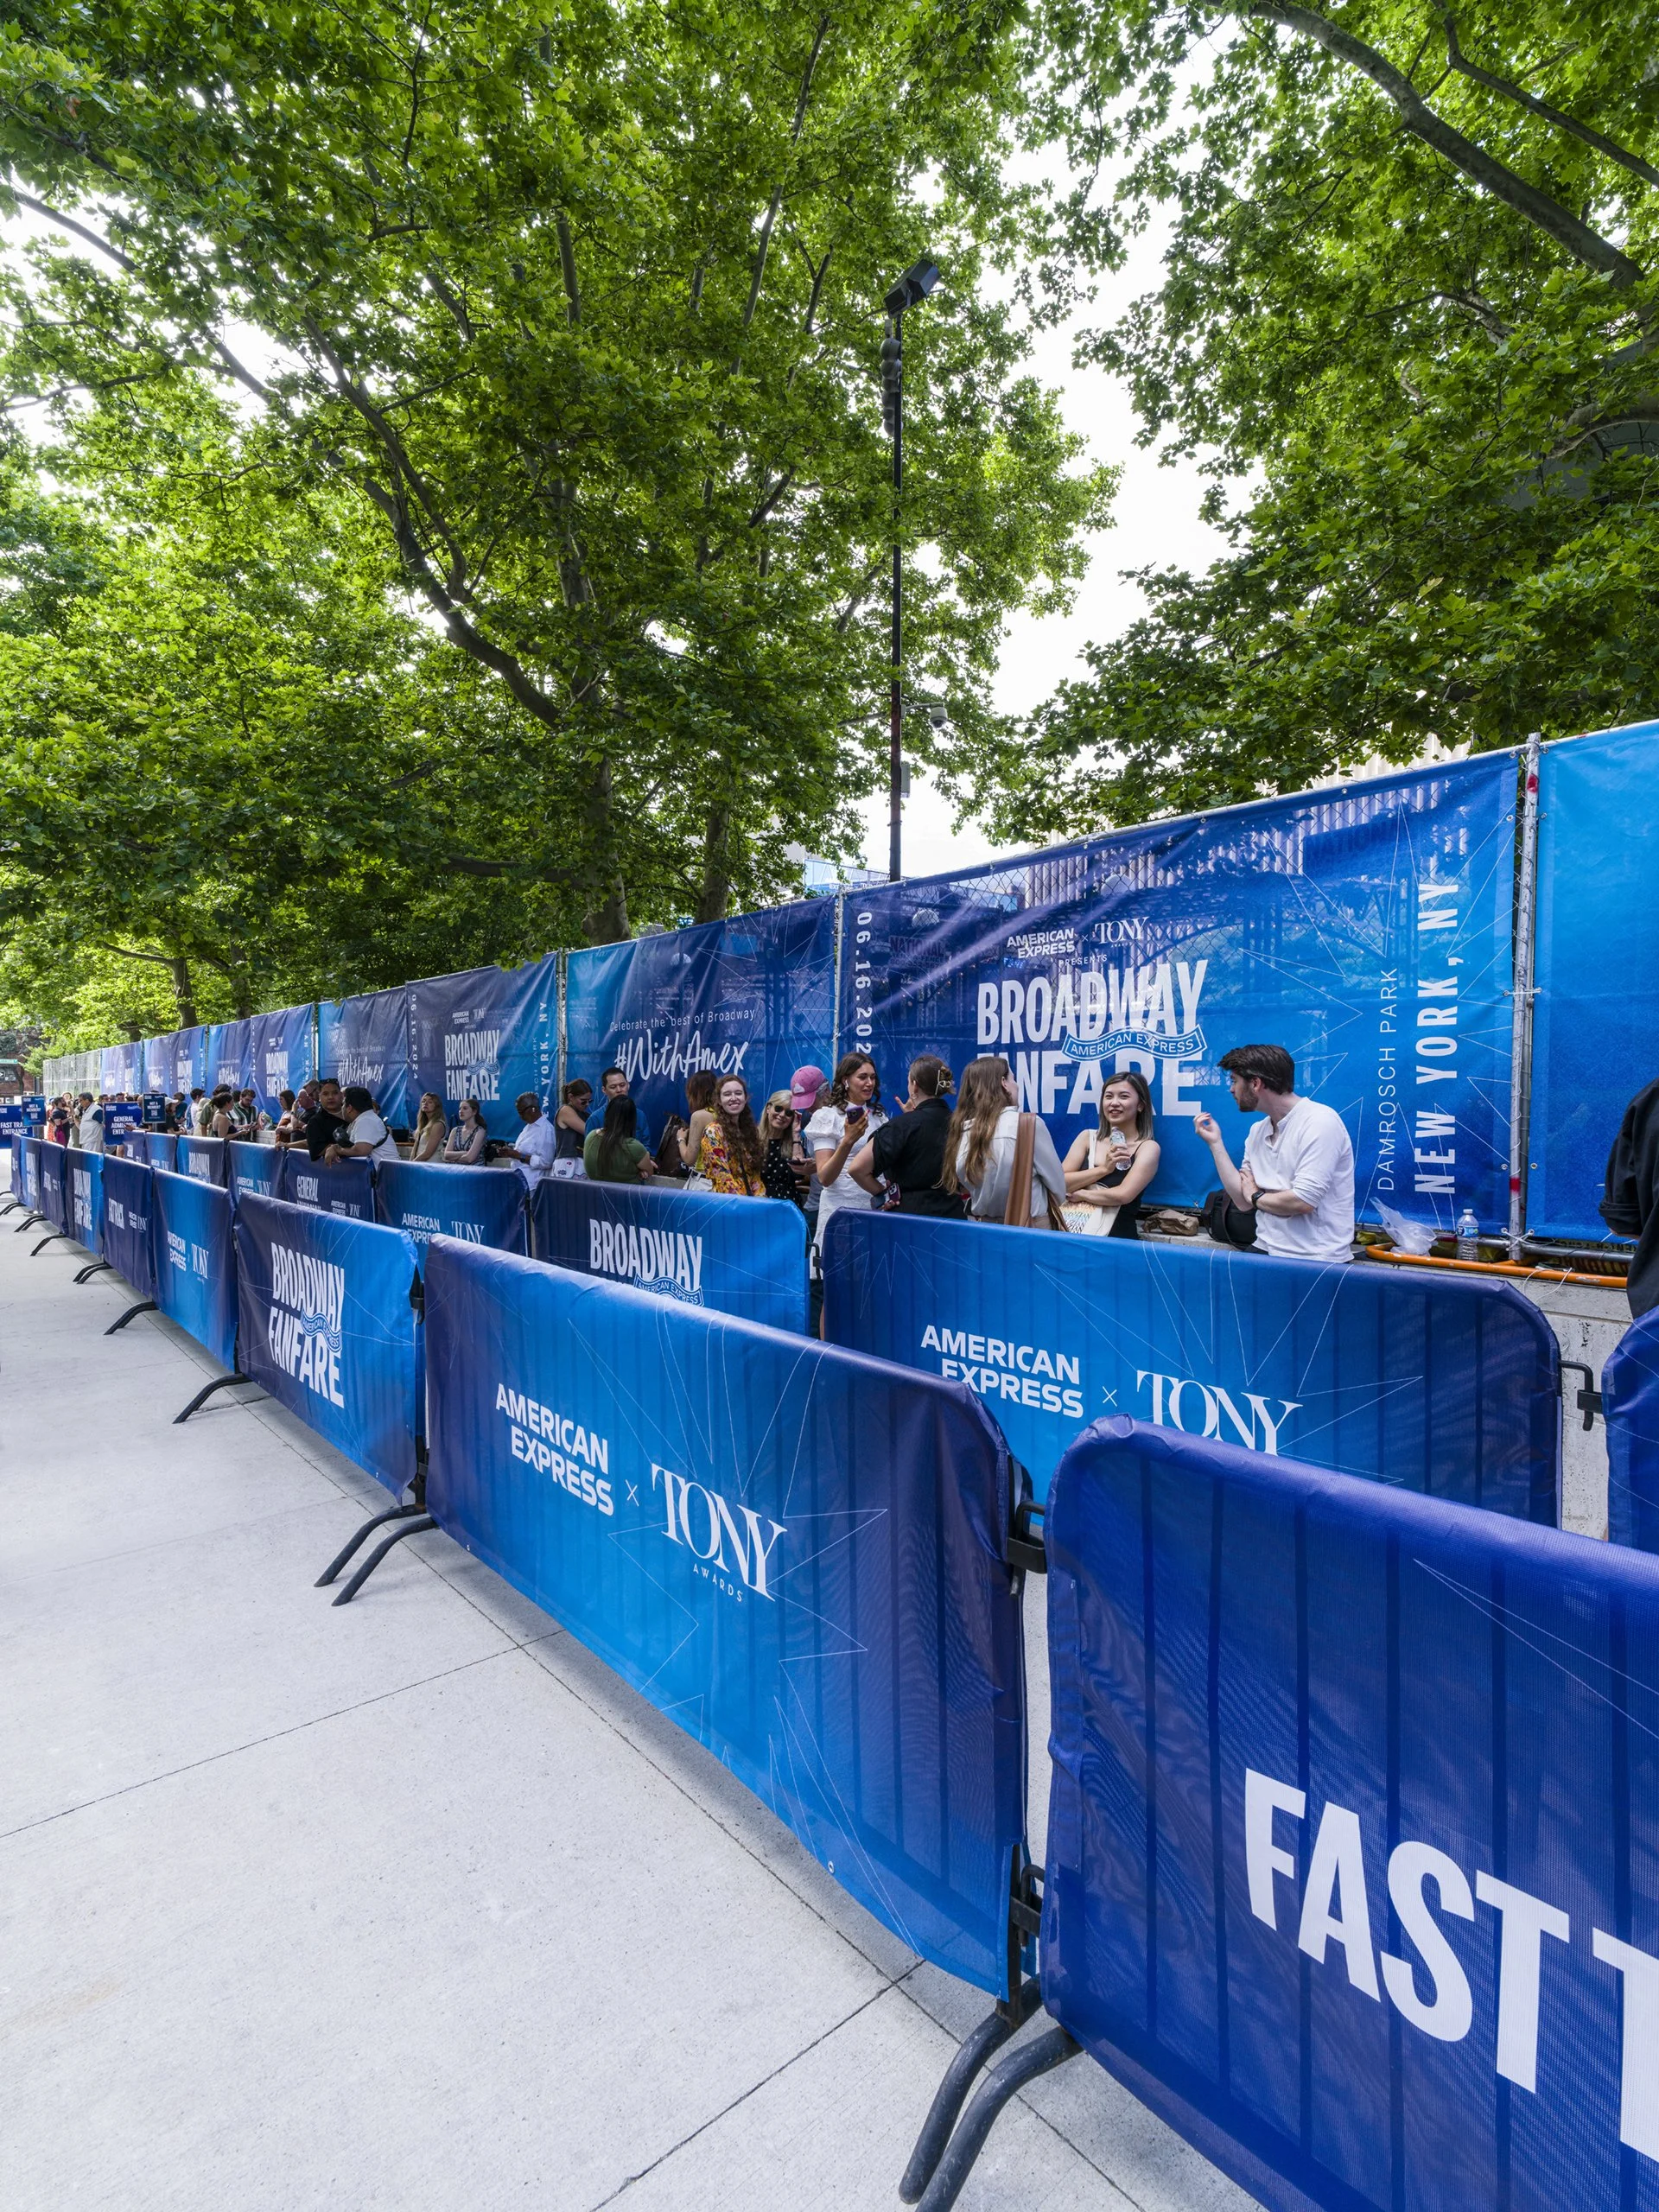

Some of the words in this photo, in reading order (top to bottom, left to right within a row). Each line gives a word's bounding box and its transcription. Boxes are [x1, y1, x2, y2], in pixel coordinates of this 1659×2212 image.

[1007, 928, 1075, 948] AMERICAN
[1094, 917, 1149, 944] TONY
[1417, 883, 1459, 931] NY
[1017, 940, 1076, 959] EXPRESS
[1058, 954, 1108, 967] PRESENTS
[855, 912, 873, 1053] 06.16.202
[977, 959, 1209, 1045] BROADWAY
[1380, 968, 1398, 1033] PARK
[539, 1002, 548, 1022] NY
[610, 1020, 648, 1032] Celebrate
[651, 1017, 665, 1028] the
[671, 1015, 690, 1027] best
[694, 1012, 704, 1024] of
[708, 1009, 755, 1023] Broadway
[1415, 957, 1465, 1084] YORK,
[444, 1030, 499, 1066] BROADWAY
[540, 1033, 550, 1085] YORK,
[614, 1029, 749, 1082] #WithAmex
[1071, 1033, 1131, 1056] AMERICAN
[1136, 1033, 1194, 1052] EXPRESS
[446, 1070, 500, 1101] FANFARE
[977, 1051, 1203, 1116] NFARE
[1378, 1047, 1396, 1191] DAMROSCH
[1414, 1110, 1456, 1194] NEW
[296, 1175, 319, 1203] GENERAL
[402, 1212, 441, 1231] AMERICAN
[450, 1221, 485, 1244] TONY
[407, 1228, 432, 1245] EXPR
[589, 1218, 702, 1291] BROADWAY
[270, 1242, 345, 1332] BROADWAY
[671, 1286, 699, 1304] EXPRESS
[268, 1306, 345, 1408] FANFARE
[921, 1325, 1081, 1384] AMERICAN
[1136, 1370, 1303, 1456] TONY
[941, 1358, 1084, 1419] EXPRESS
[495, 1382, 608, 1475] AMERICAN
[652, 1462, 788, 1602] TONY
[511, 1425, 614, 1516] EXPRESS
[693, 1563, 743, 1603] AWARDS
[1244, 1767, 1570, 2094] FAST
